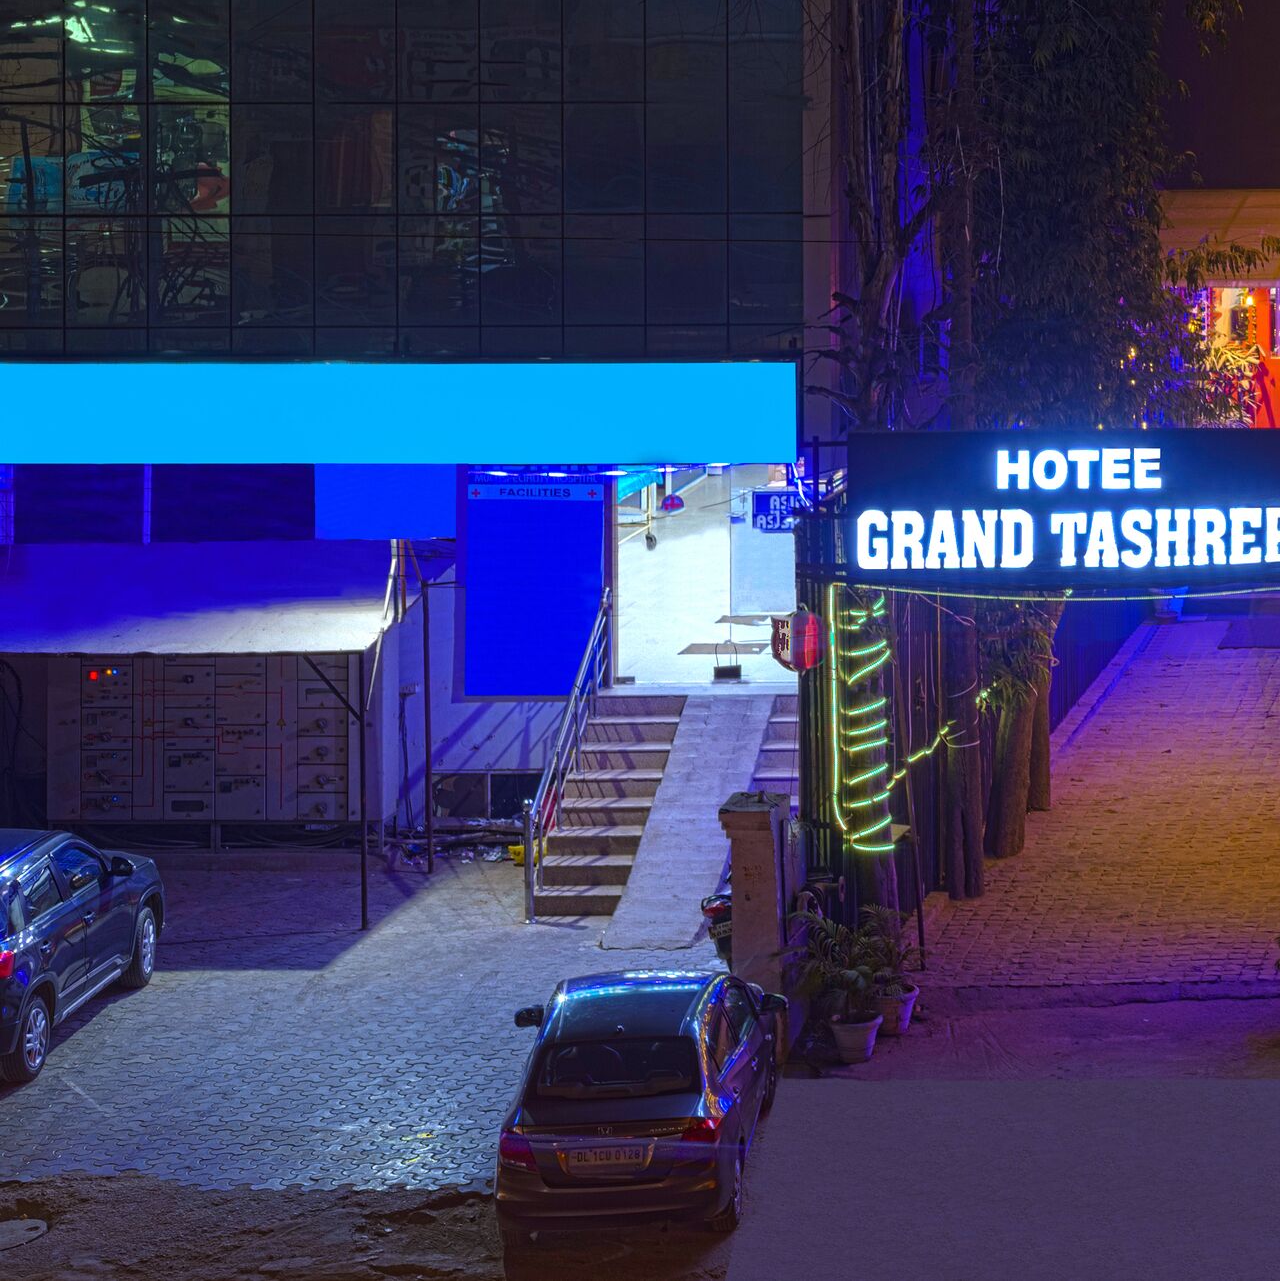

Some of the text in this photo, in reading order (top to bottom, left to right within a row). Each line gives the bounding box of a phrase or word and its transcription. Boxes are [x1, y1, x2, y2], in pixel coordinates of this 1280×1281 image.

[996, 448, 1162, 490] HOTEE
[500, 488, 571, 498] FACILITIES
[855, 508, 1035, 571] GRAND
[577, 1151, 588, 1163] DL
